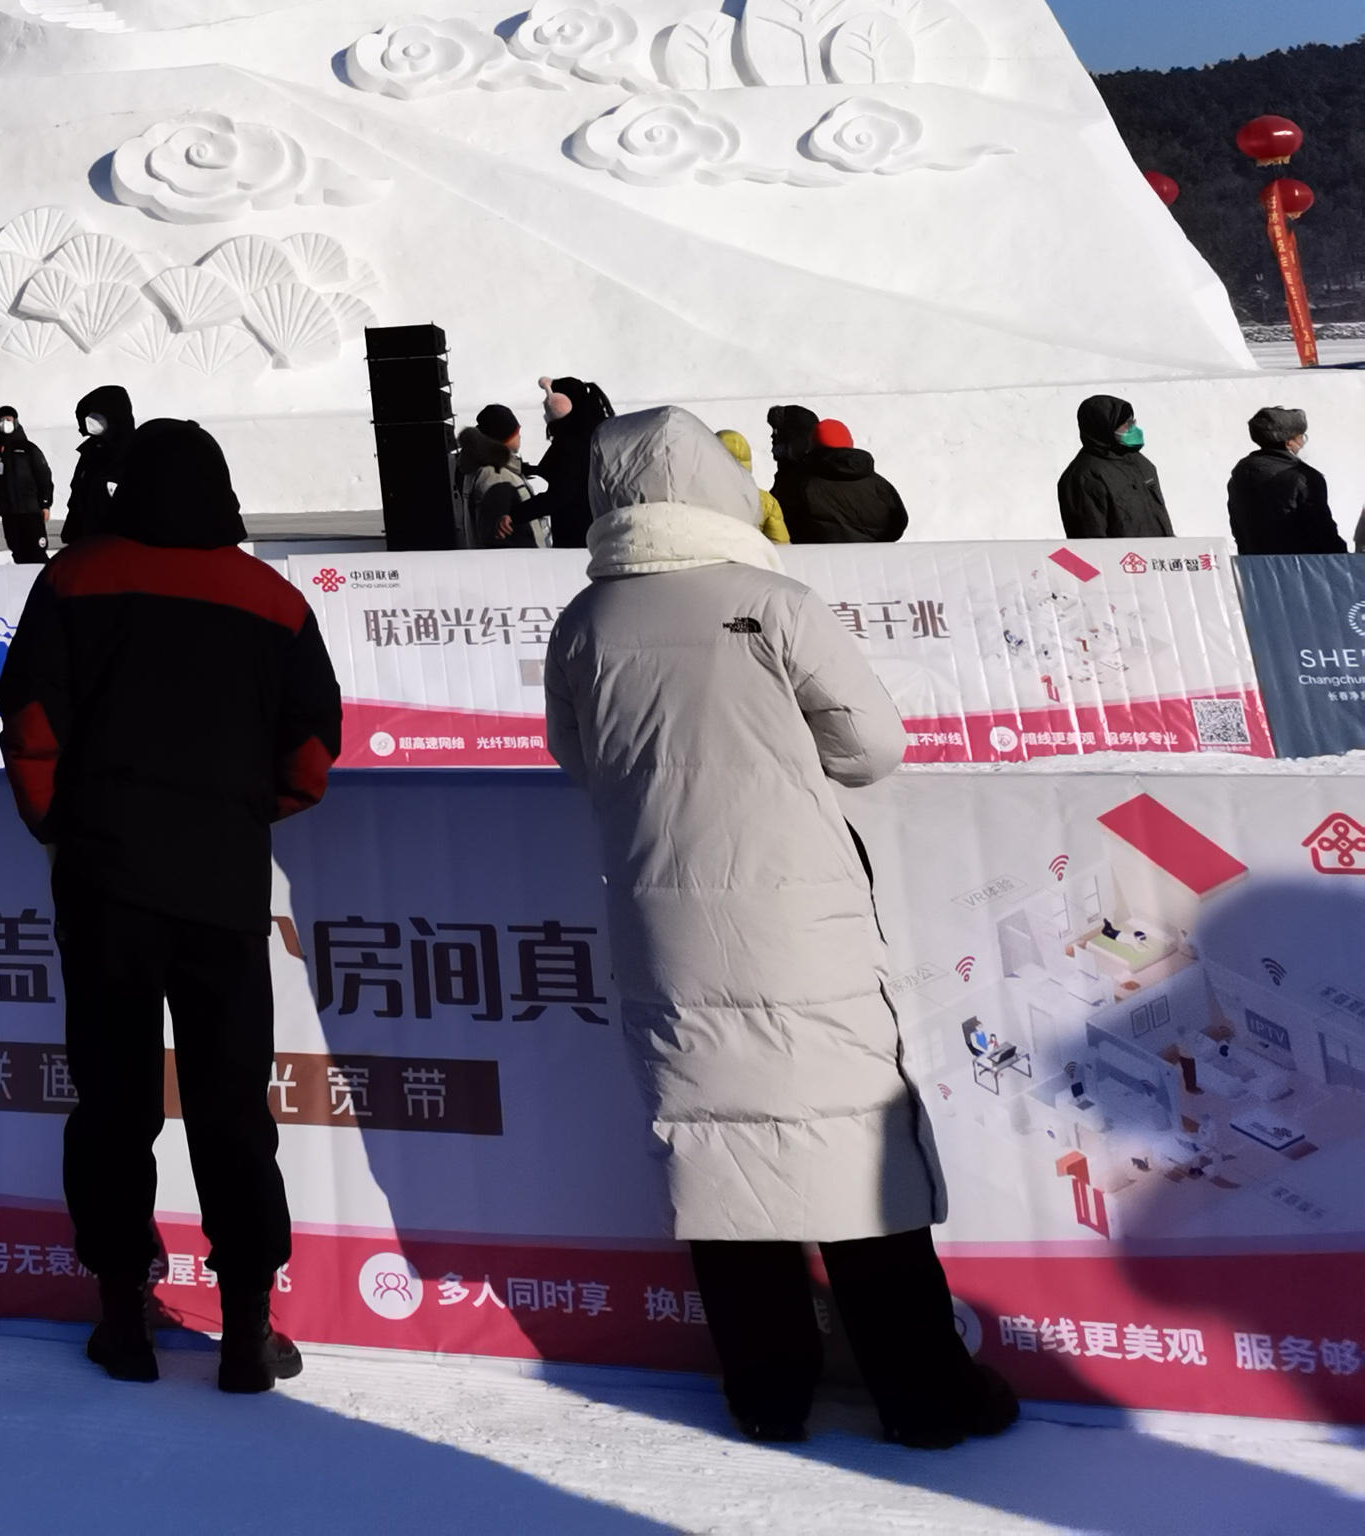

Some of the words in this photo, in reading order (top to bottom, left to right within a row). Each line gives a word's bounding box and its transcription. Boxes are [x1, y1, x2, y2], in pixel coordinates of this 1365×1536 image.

[363, 606, 565, 647] 联通光纤全
[1300, 649, 1365, 668] SHE
[399, 737, 465, 750] 超高速网络
[476, 736, 544, 750] 光纤到房间
[313, 915, 610, 1026] 房间真
[1248, 1017, 1287, 1045] IPTV
[437, 1271, 613, 1317] 多人同时享
[998, 1315, 1208, 1367] 暗线更美观
